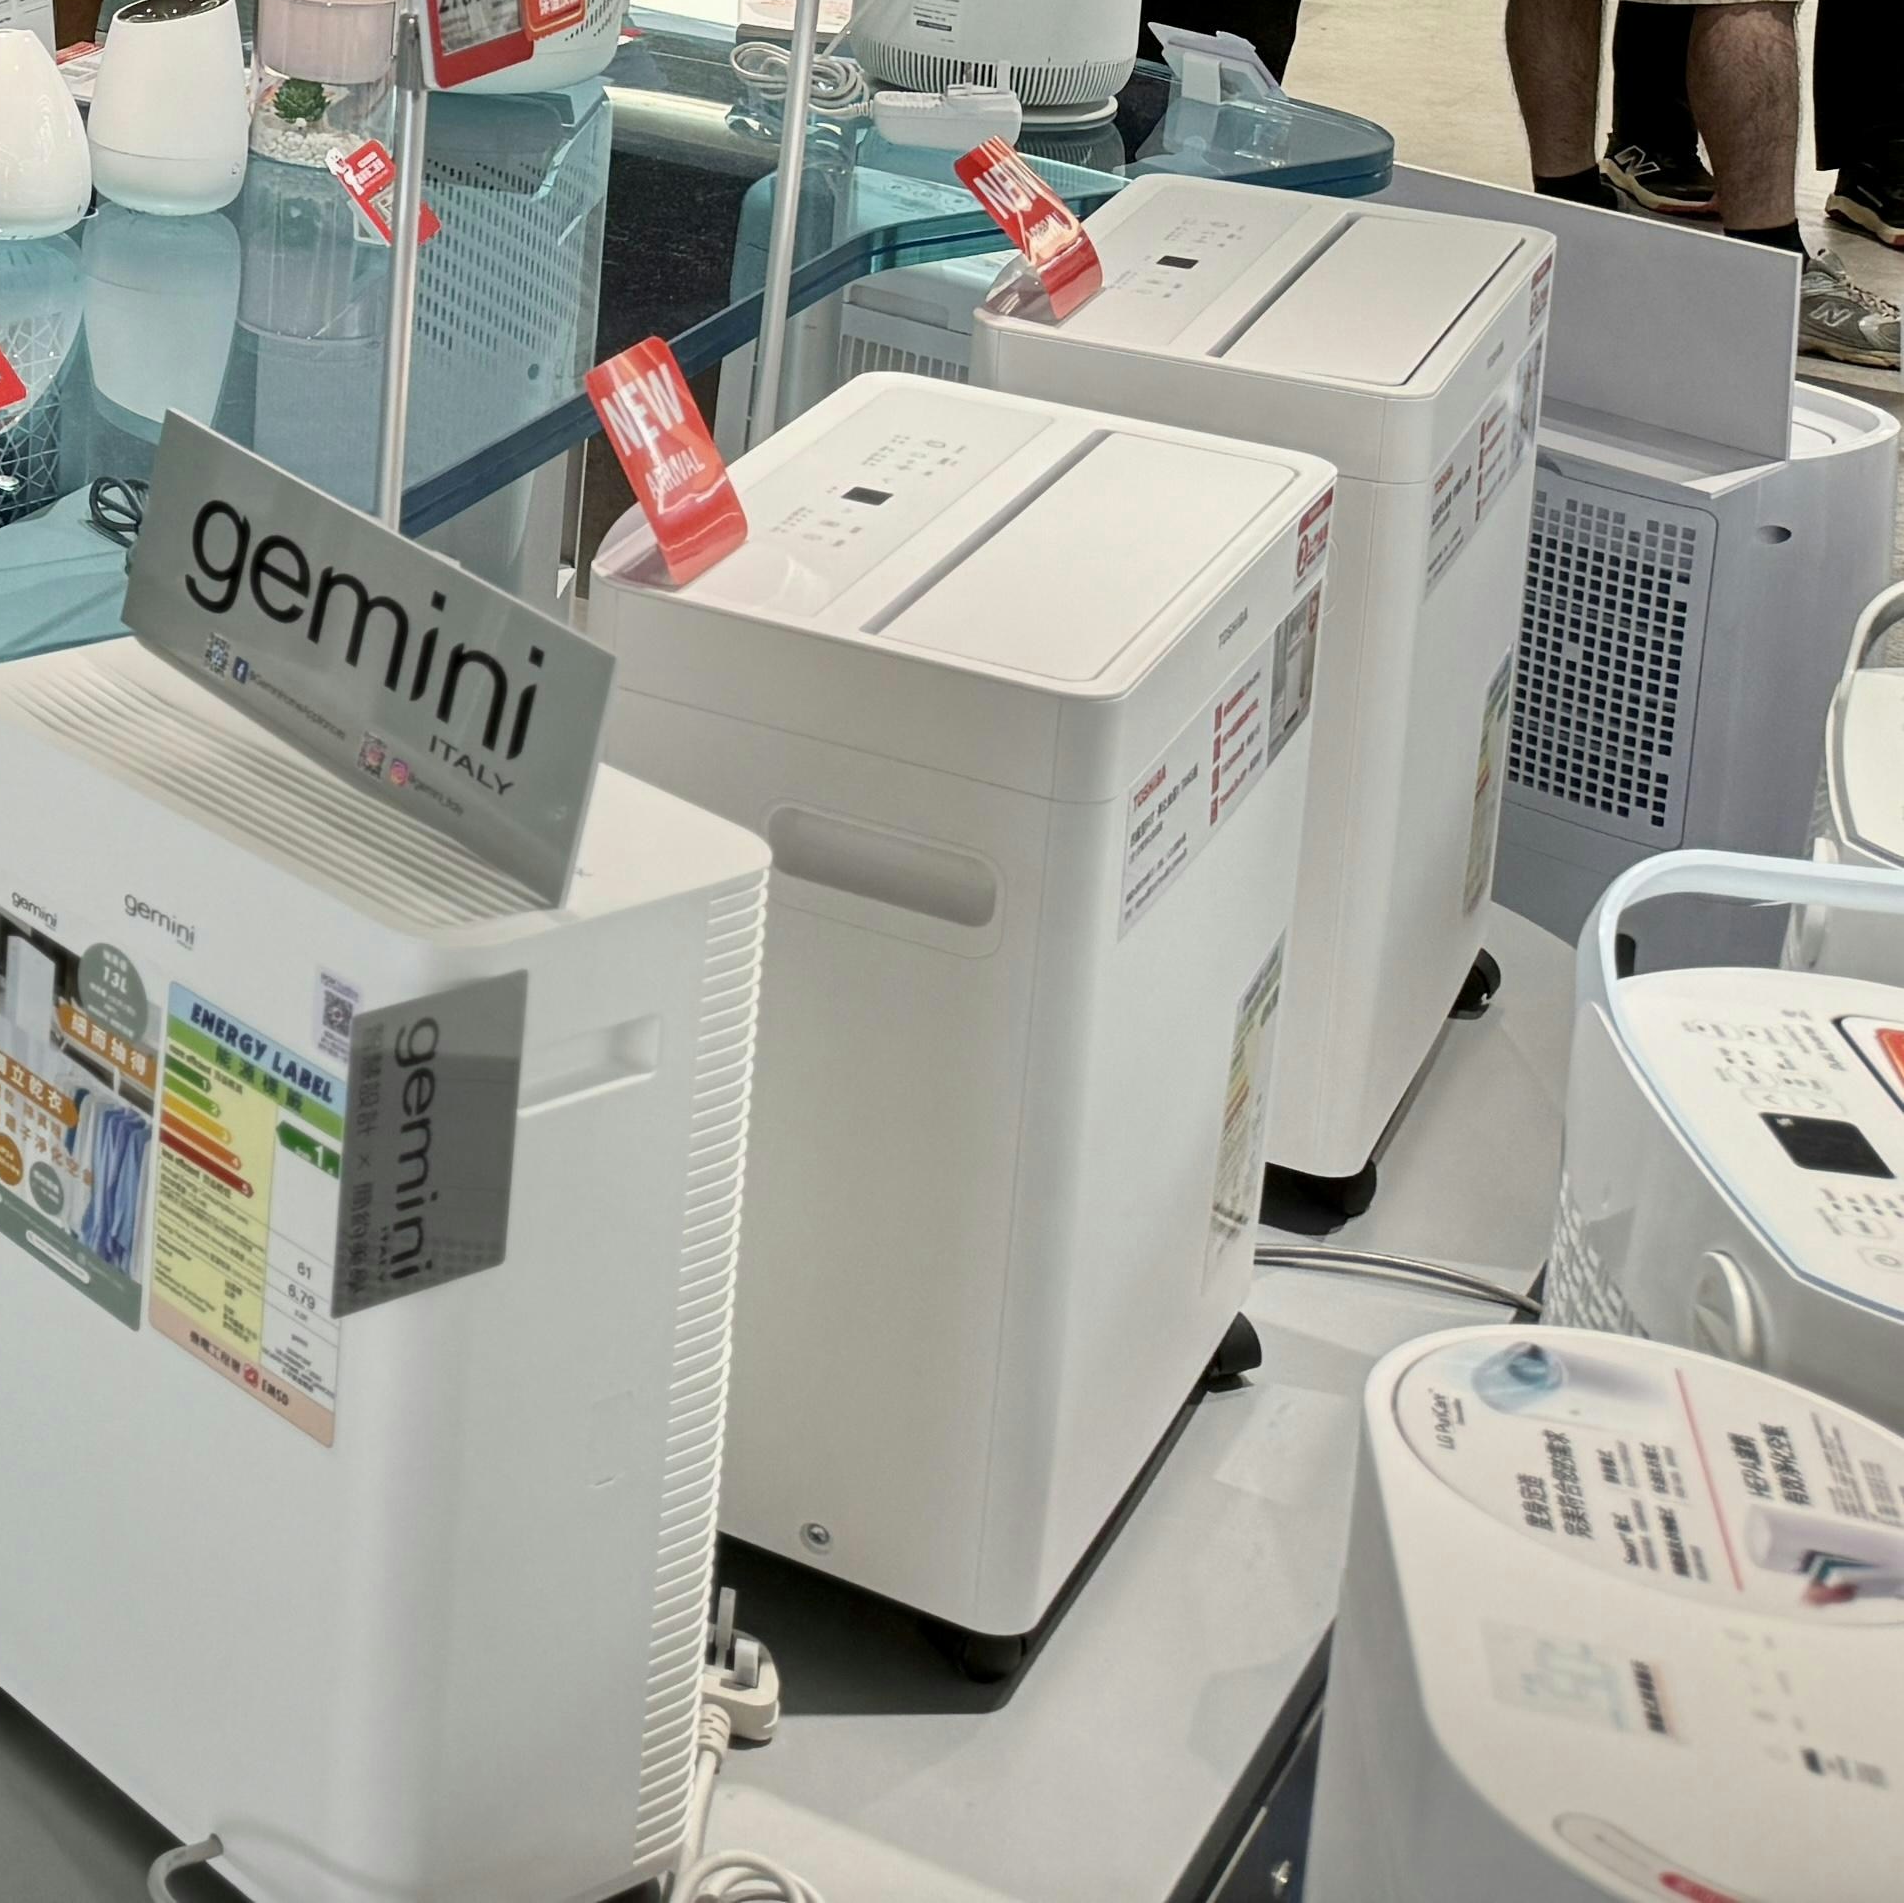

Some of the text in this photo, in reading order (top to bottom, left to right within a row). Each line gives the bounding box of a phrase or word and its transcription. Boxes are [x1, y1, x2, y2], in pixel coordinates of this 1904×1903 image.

[607, 361, 686, 456] NEW
[183, 498, 548, 762] gemini
[429, 734, 515, 798] ITALY
[11, 891, 58, 929] gemini
[123, 893, 196, 946] gemini
[189, 1002, 268, 1062] ENERGY
[272, 1050, 335, 1104] LABEL
[392, 1016, 441, 1280] gemini
